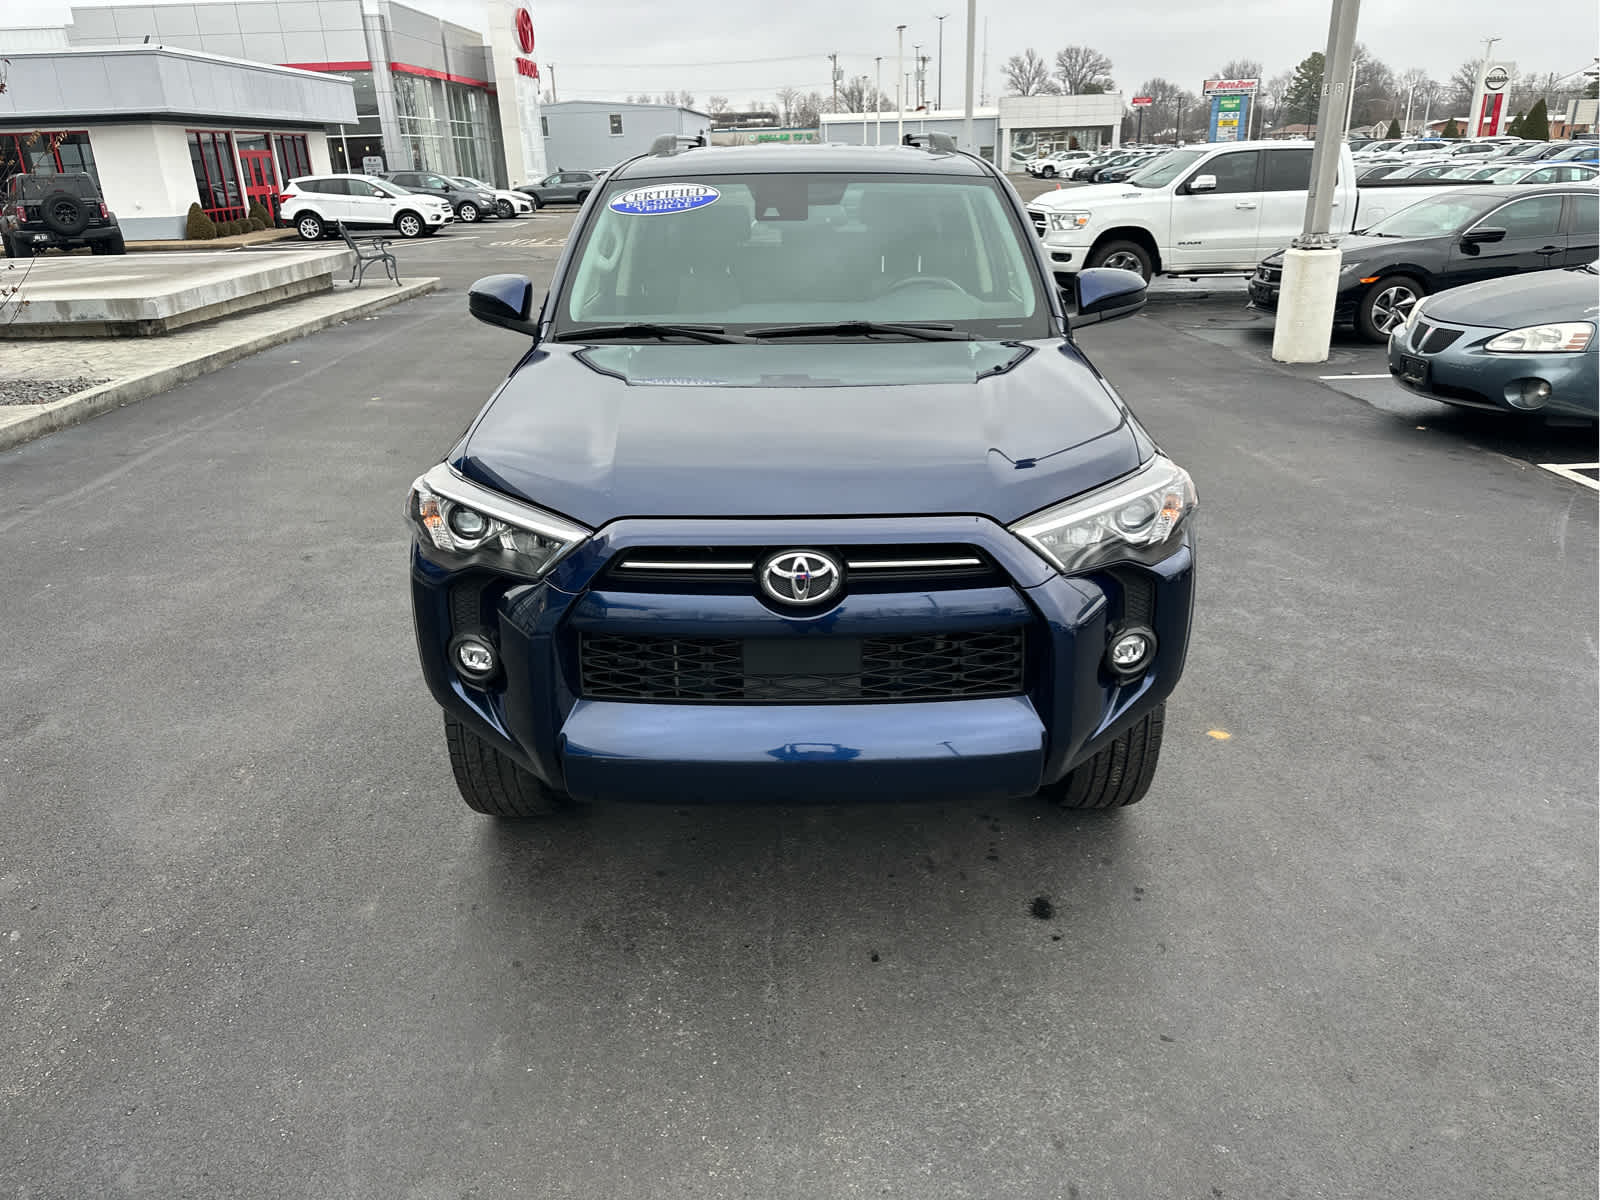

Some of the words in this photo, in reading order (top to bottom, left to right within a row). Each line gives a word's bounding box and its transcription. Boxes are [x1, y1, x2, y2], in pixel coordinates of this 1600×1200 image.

[622, 186, 708, 203] CERTIFIED
[624, 196, 704, 209] PRE-OWNED
[637, 201, 693, 212] VEHICLE
